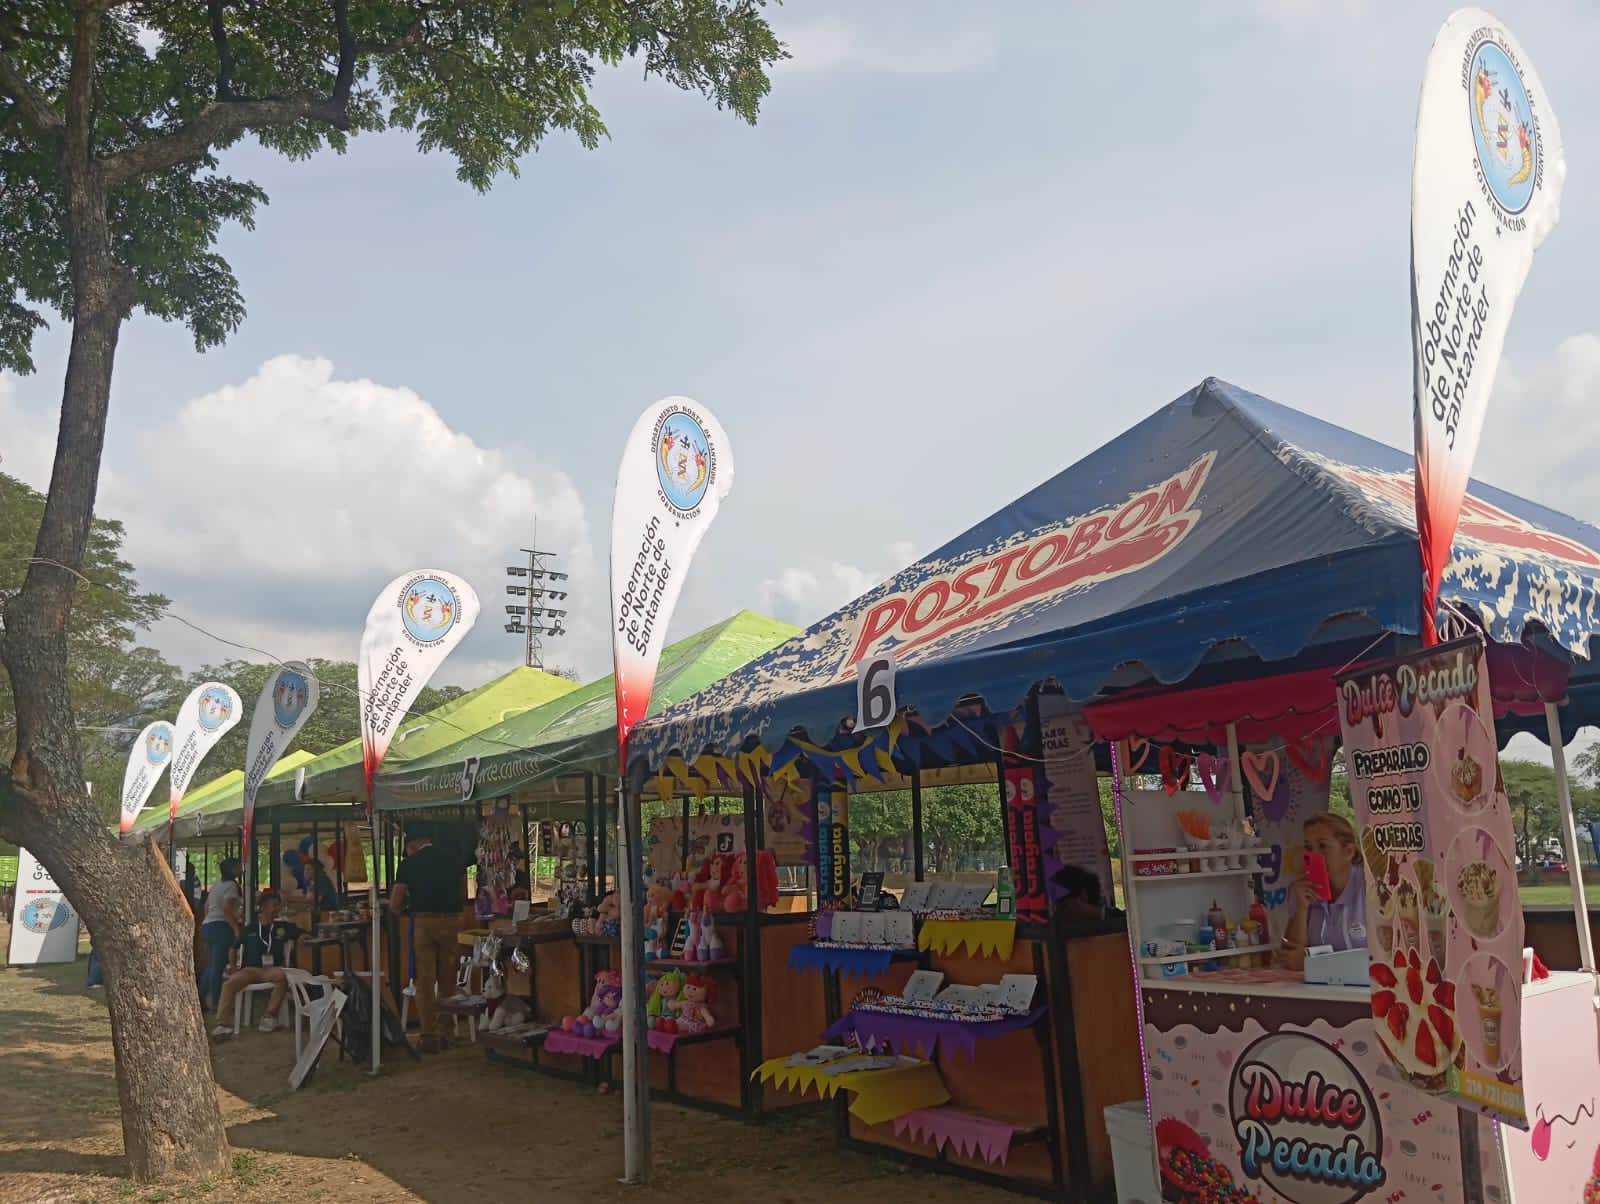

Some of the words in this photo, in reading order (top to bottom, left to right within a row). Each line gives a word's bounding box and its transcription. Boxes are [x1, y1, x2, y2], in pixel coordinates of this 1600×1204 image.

[1462, 27, 1494, 90] DEPARTAMENTO
[1533, 113, 1545, 191] SANTANDER
[1432, 375, 1450, 422] de
[1441, 283, 1471, 375] Norte
[1466, 244, 1484, 284] de
[653, 538, 666, 561] de
[846, 458, 1210, 666] POSTOBON
[632, 563, 656, 617] Norte
[635, 560, 672, 656] Santander
[627, 619, 639, 646] de
[375, 677, 399, 712] Norte
[395, 660, 408, 676] de
[863, 660, 892, 728] 6
[1343, 673, 1396, 727] Dulce
[1396, 652, 1478, 718] Pecado
[370, 712, 381, 729] de
[376, 673, 413, 736] Santander
[463, 757, 478, 798] 5
[1353, 743, 1429, 779] PREPARALO
[1368, 786, 1401, 813] COMO
[1401, 783, 1421, 812] TU
[1241, 1063, 1363, 1127] Dulce
[1237, 1118, 1384, 1186] Pecado
